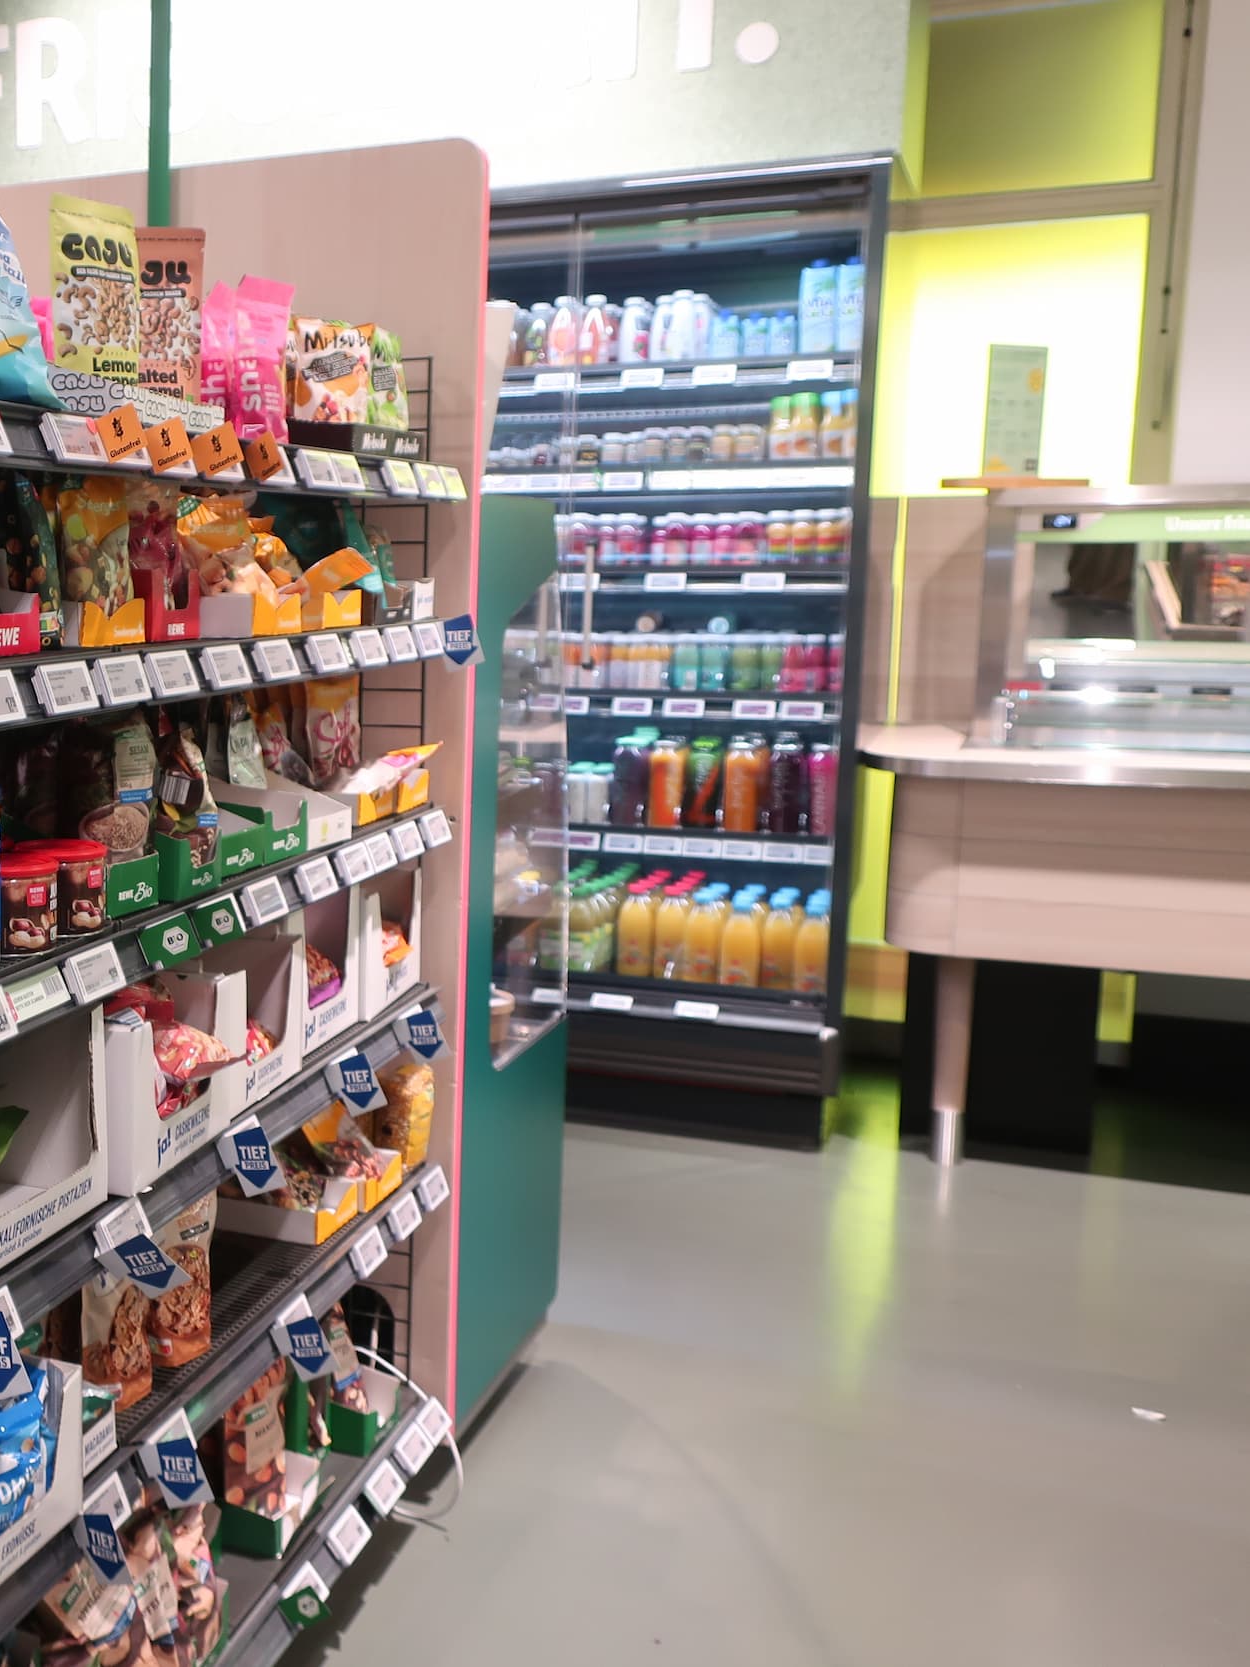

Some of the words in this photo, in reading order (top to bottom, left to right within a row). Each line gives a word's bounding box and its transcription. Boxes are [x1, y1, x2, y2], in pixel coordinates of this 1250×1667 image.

[2, 263, 27, 284] salt
[92, 356, 138, 374] Lemon
[137, 369, 178, 384] alted
[109, 437, 142, 459] Glutenfrei
[157, 448, 188, 467] Glutenfrei
[209, 453, 239, 473] Glutenfrei
[446, 629, 472, 642] TIEF
[283, 832, 300, 852] Bio
[239, 847, 255, 867] Bio
[117, 889, 134, 902] REWE
[133, 881, 154, 903] Bio
[304, 1016, 317, 1042] ja!
[410, 1023, 437, 1037] TIEF
[343, 1068, 371, 1084] TIEF
[348, 1081, 372, 1093] PREIS
[157, 1129, 172, 1168] ja!
[238, 1144, 267, 1161] TIEF
[243, 1159, 270, 1170] PREIS
[57, 1176, 93, 1212] PISTAZIEN
[125, 1250, 159, 1267] TIEF
[134, 1263, 166, 1278] PREIS
[292, 1333, 320, 1347] TIEF
[160, 1453, 195, 1473] TIEF
[88, 1528, 116, 1550] TIEF
